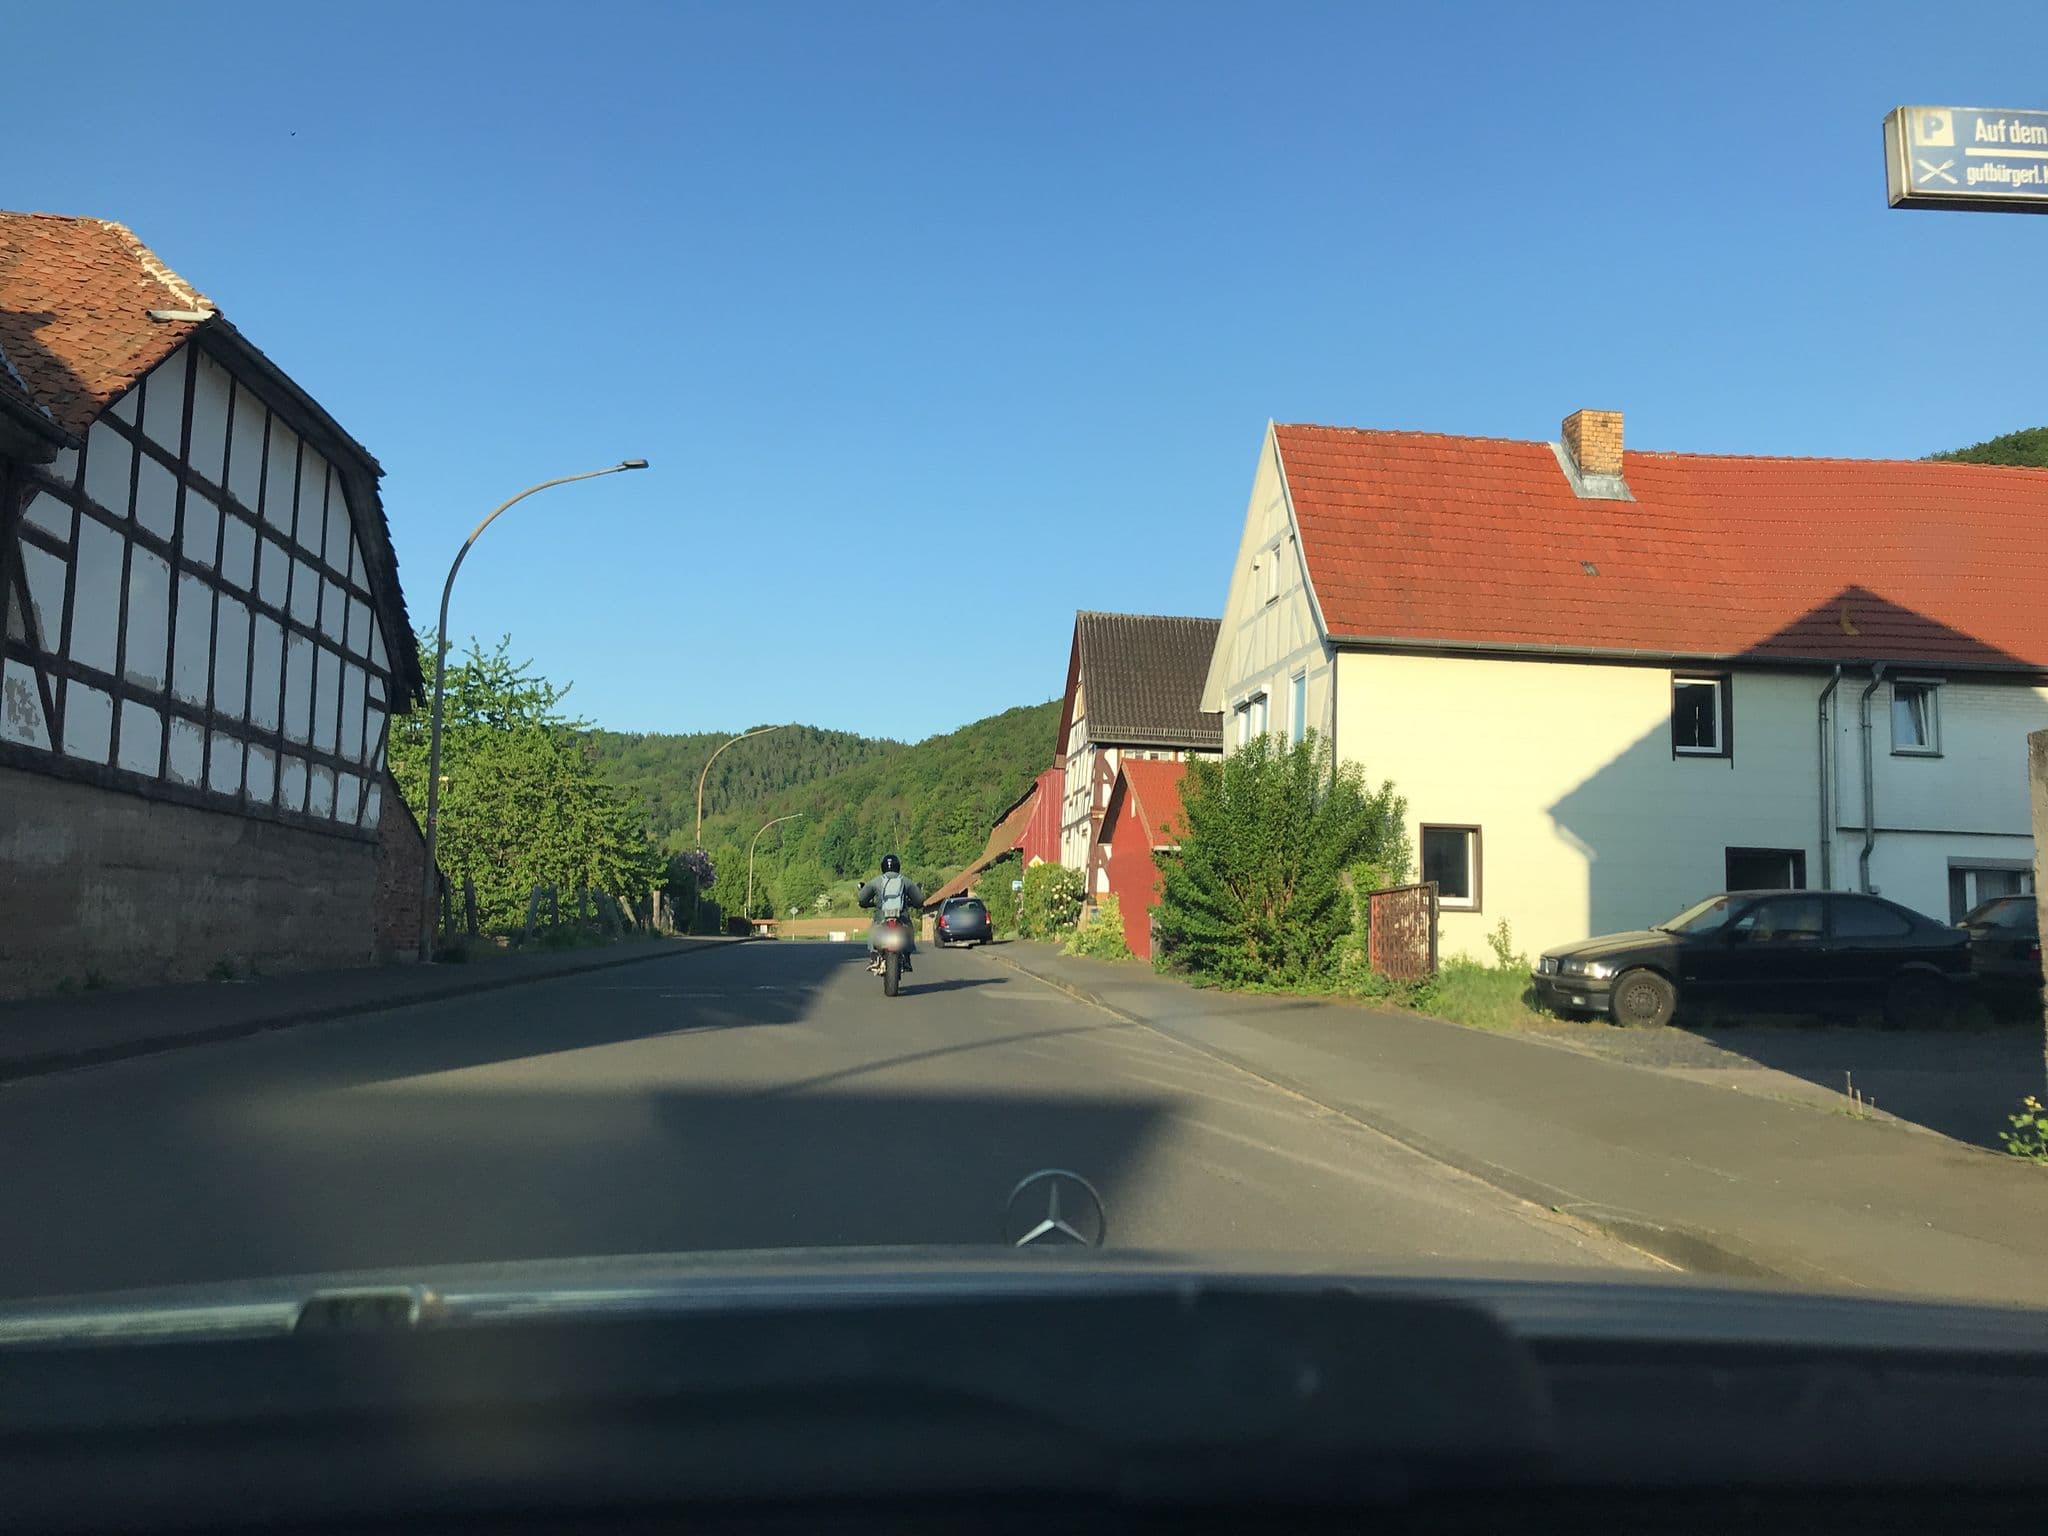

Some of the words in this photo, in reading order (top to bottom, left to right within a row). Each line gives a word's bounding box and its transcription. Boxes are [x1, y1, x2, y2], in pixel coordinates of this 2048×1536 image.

[1923, 116, 1944, 139] P
[1975, 117, 2006, 142] Auf
[2009, 119, 2048, 144] dem
